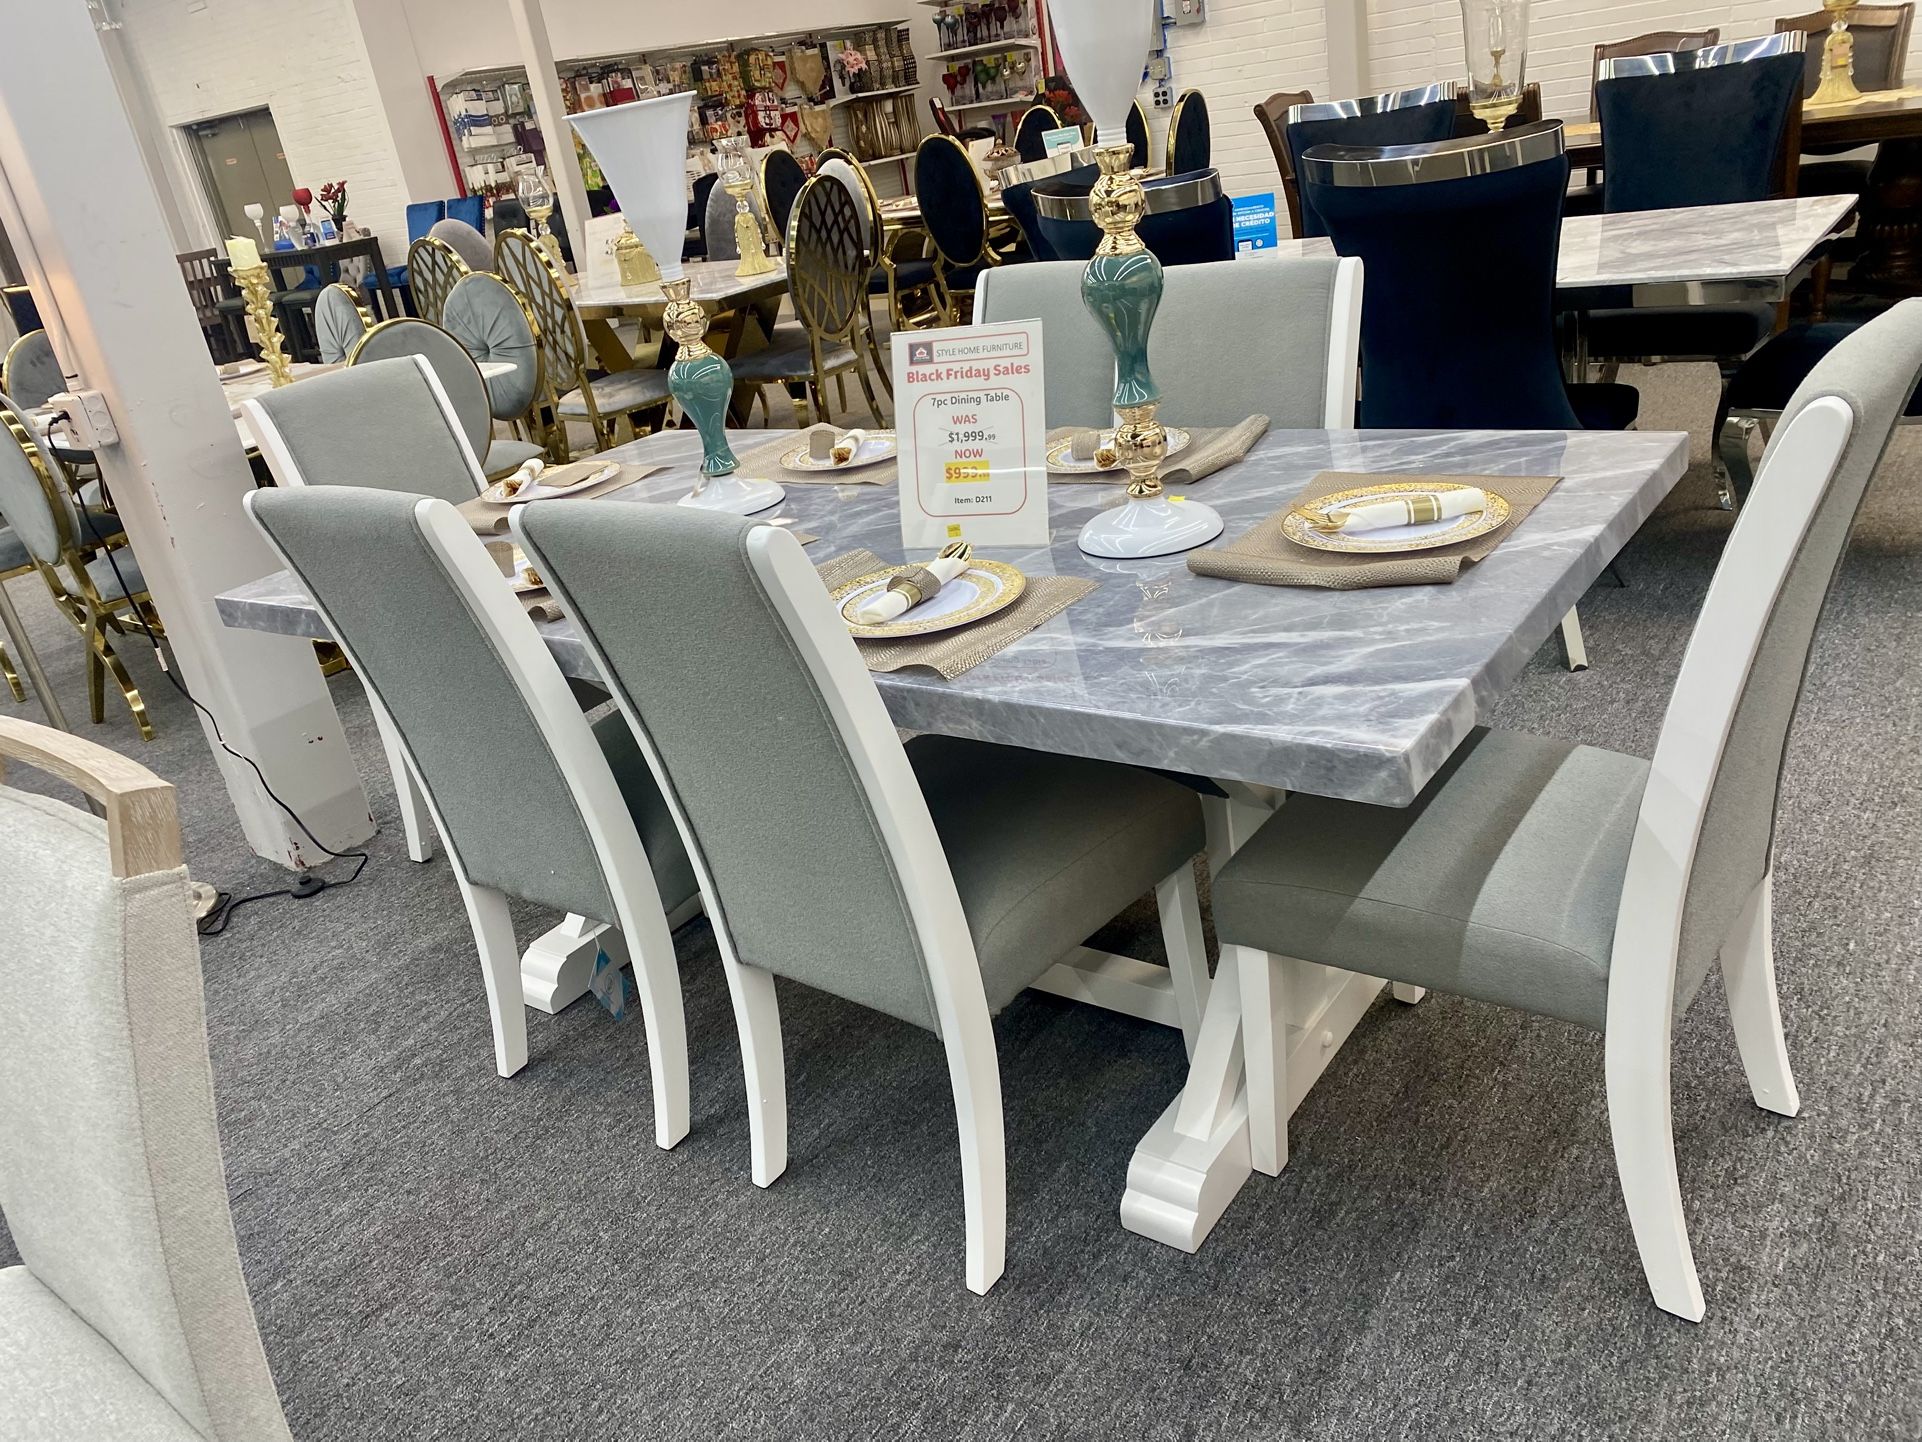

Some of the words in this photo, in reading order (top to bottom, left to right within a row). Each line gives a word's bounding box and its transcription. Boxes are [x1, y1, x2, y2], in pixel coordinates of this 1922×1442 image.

[936, 347, 956, 358] STYLE
[958, 345, 980, 355] HOME
[982, 342, 1023, 353] FURNITURE
[907, 369, 943, 383] Black
[946, 366, 990, 380] Friday
[993, 363, 1030, 376] Sales
[931, 397, 948, 408] 7pc
[951, 394, 981, 406] Dining
[984, 392, 1010, 403] Table
[952, 414, 978, 425] WAS
[948, 430, 996, 443] $1,999.99
[954, 448, 983, 459] NOW
[975, 496, 992, 504] D211
